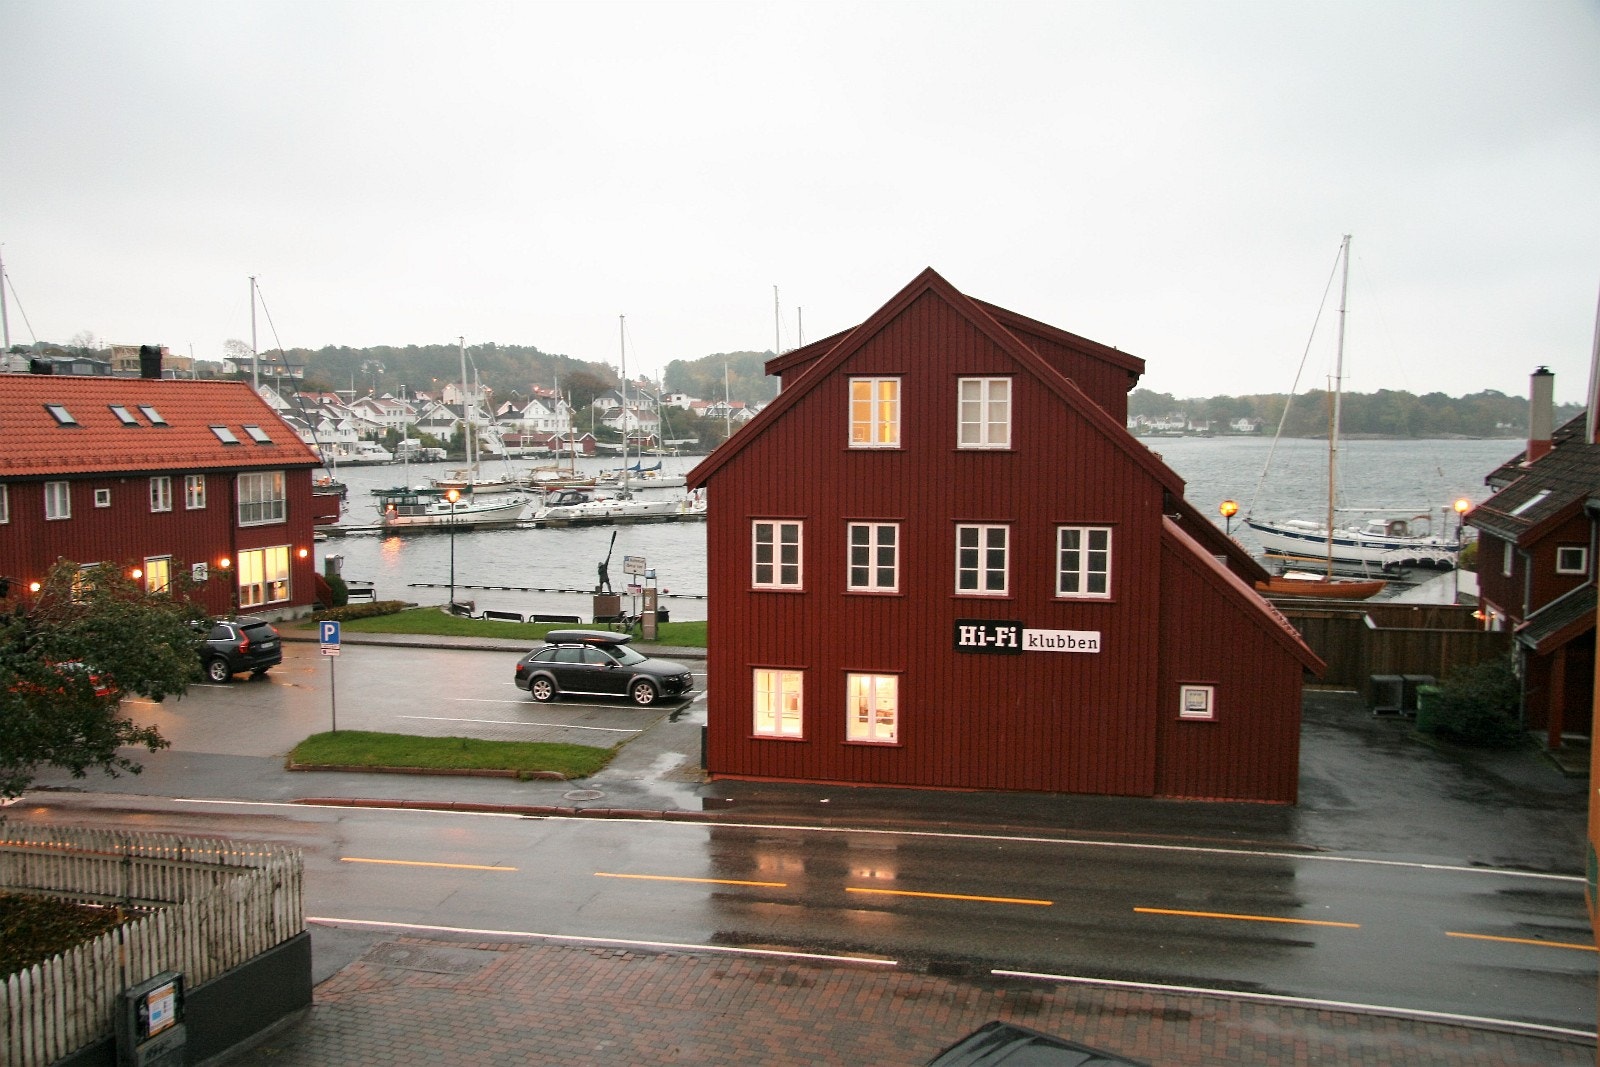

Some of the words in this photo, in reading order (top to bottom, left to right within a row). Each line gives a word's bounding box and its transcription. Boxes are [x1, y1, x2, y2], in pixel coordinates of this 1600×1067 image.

[324, 624, 335, 641] P
[958, 625, 1018, 648] Hi-Fi
[1028, 633, 1098, 649] klubben
